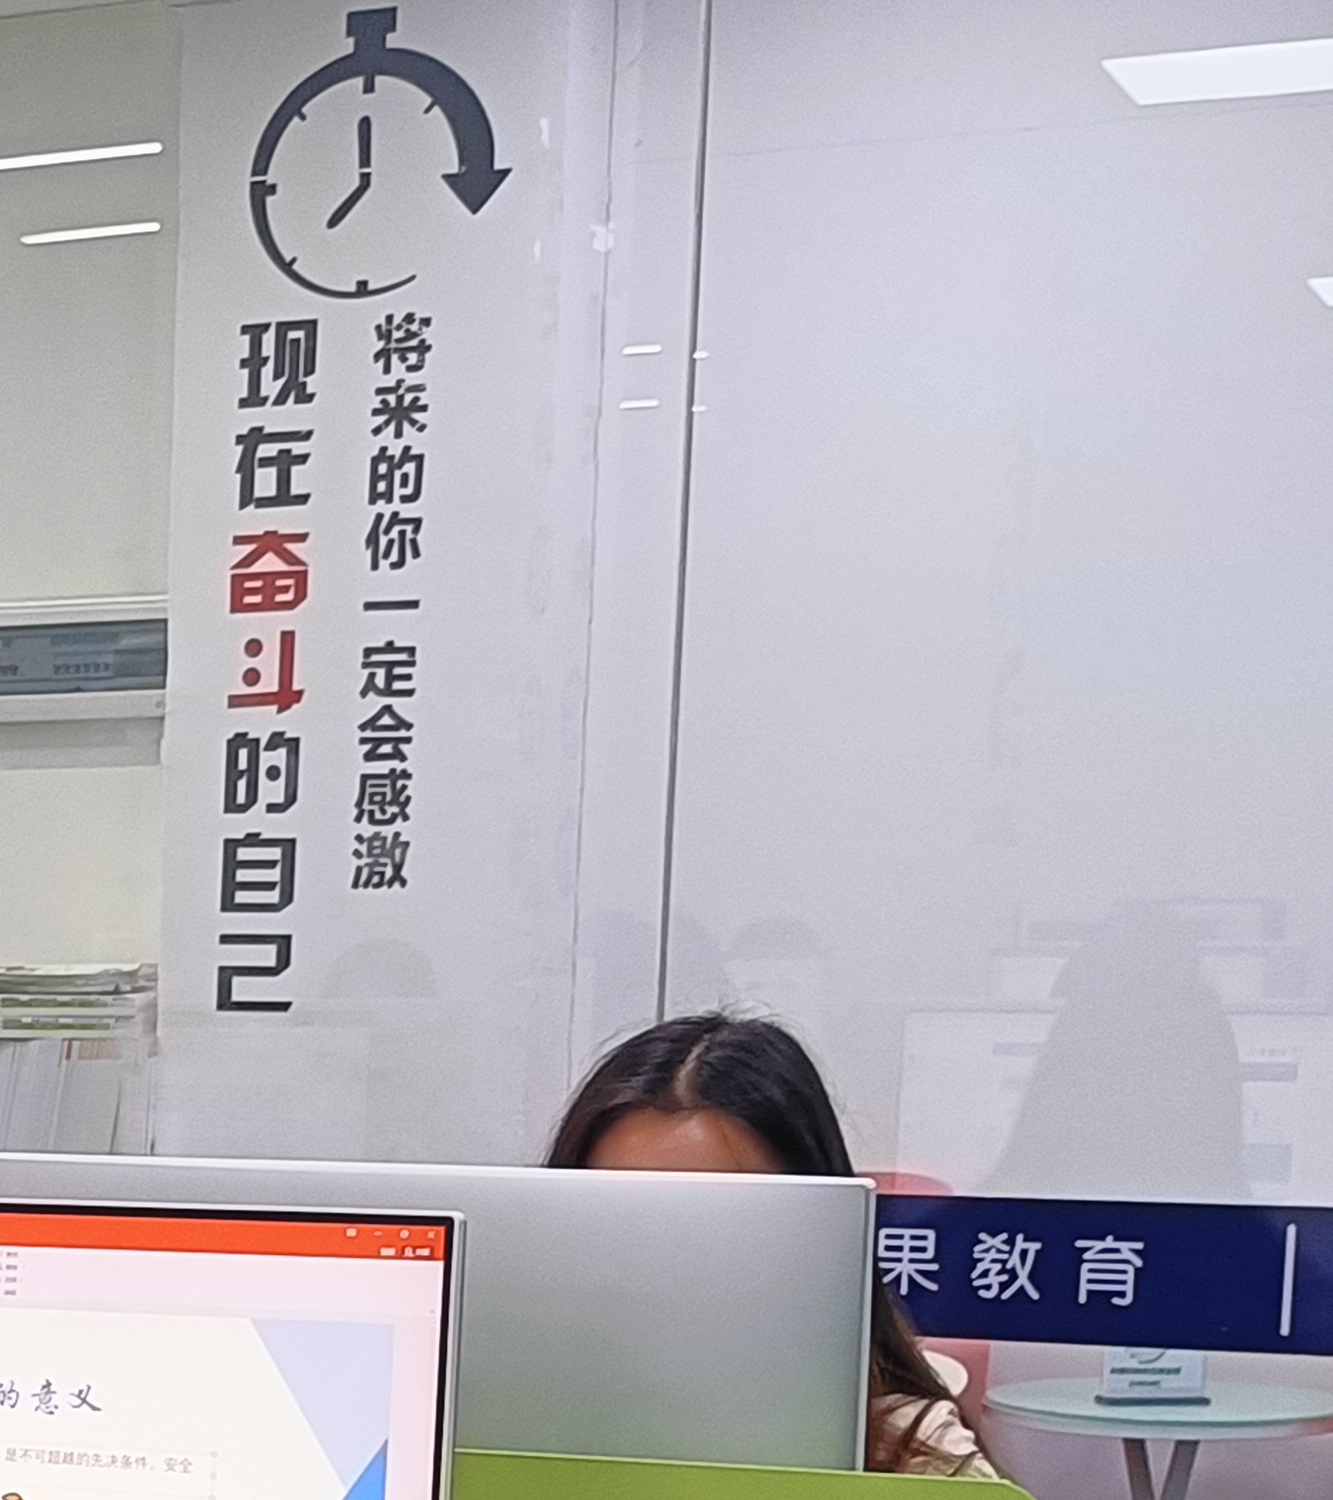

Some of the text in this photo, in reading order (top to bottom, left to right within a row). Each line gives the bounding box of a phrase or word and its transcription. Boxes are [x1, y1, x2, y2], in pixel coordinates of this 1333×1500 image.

[216, 318, 318, 1012] 现在奋斗的自己
[351, 312, 433, 889] 将来的你一定会感激
